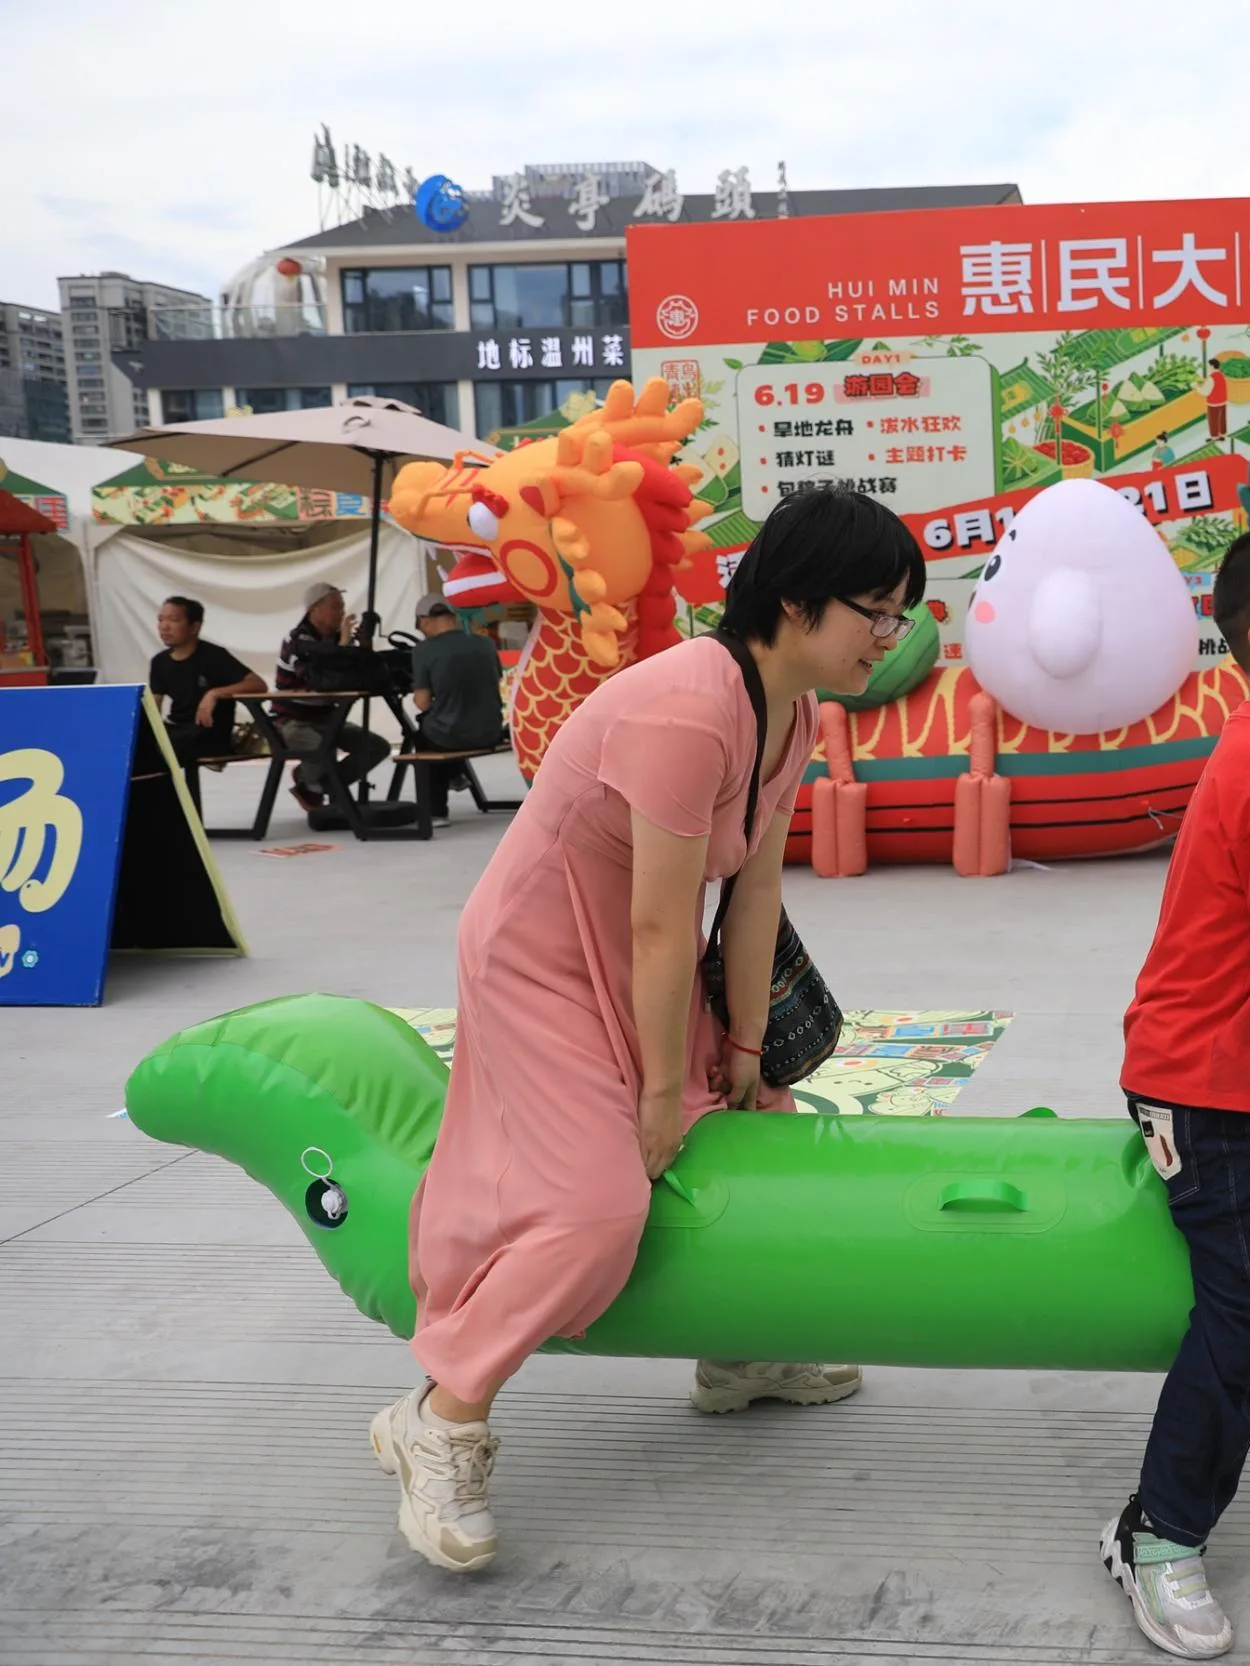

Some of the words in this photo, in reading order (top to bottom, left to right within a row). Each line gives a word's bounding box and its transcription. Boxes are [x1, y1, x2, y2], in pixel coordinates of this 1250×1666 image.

[828, 281, 874, 299] HUI
[889, 278, 939, 296] MIN
[747, 306, 820, 326] FOOD
[835, 301, 940, 321] STALLS
[477, 334, 624, 370] 地标温州菜
[861, 354, 901, 365] DAY1
[754, 382, 825, 407] 6.19
[844, 371, 920, 398] 游园会
[774, 418, 854, 438] 旱地龙舟
[880, 415, 962, 434] 泼水狂欢
[776, 450, 835, 468] 猜灯谜
[885, 445, 968, 464] 主题打卡
